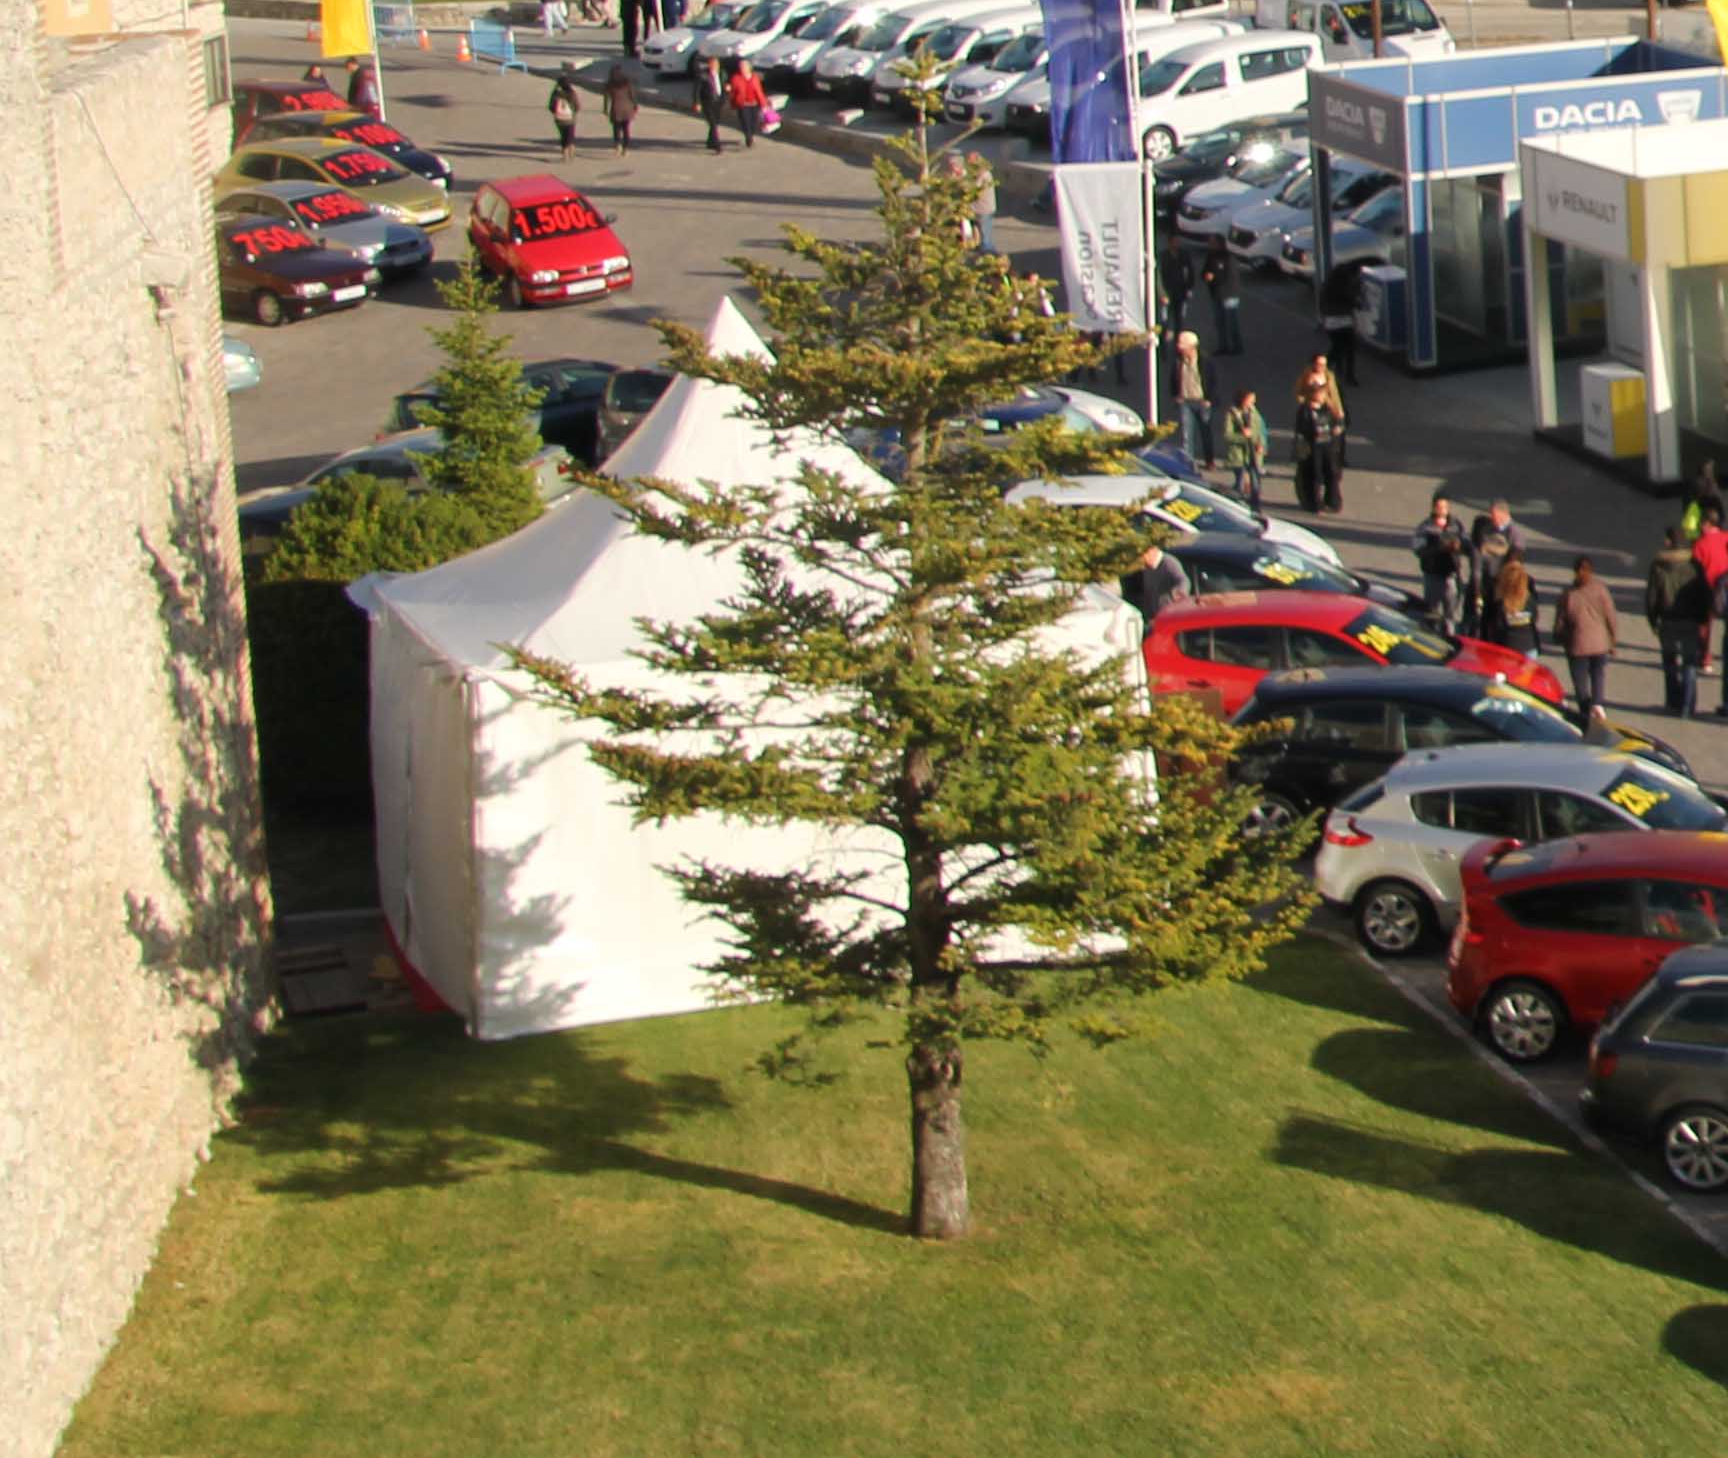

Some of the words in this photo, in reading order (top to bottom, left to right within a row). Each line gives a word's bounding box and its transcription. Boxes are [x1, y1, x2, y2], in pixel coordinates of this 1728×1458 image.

[1325, 95, 1365, 127] DACIA
[1535, 99, 1643, 129] DACIA
[1561, 190, 1617, 224] RENAULT
